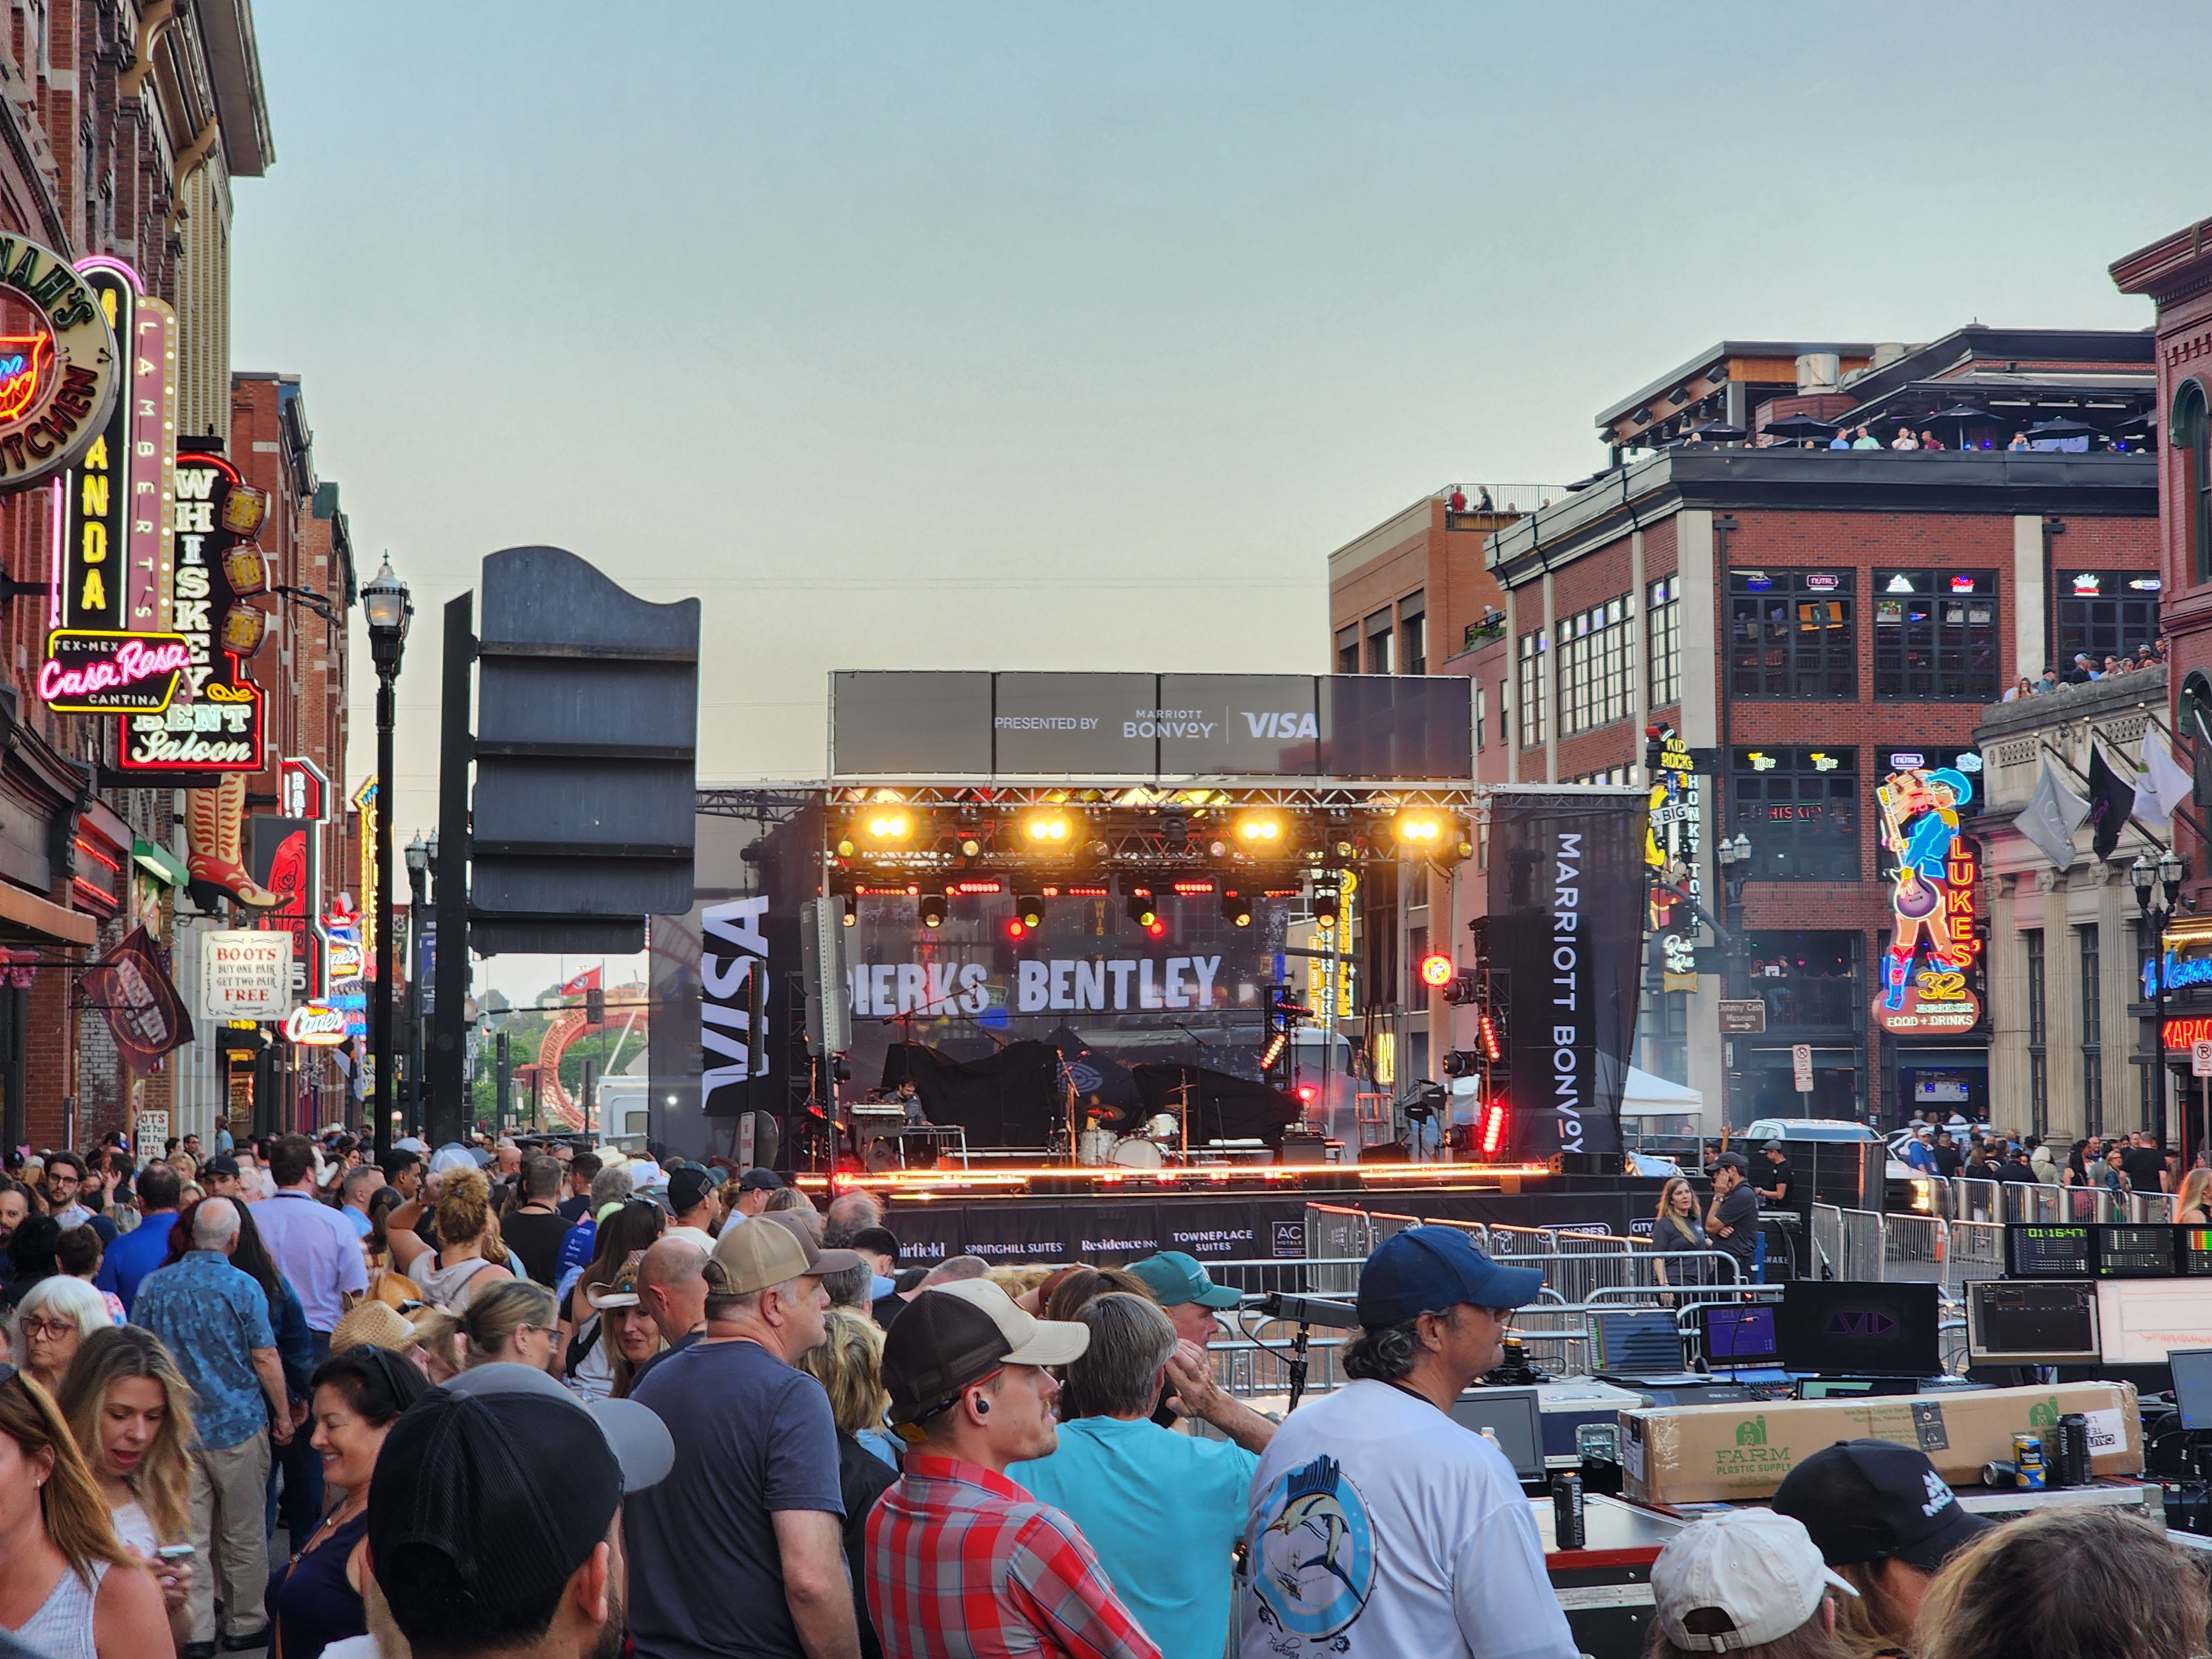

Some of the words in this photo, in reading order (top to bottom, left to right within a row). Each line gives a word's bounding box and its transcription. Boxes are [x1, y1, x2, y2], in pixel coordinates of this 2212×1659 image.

[173, 468, 220, 697] WHISKEY
[54, 640, 118, 652] TEX-MEX
[38, 659, 121, 701] Casa
[115, 639, 191, 686] Rosa
[88, 694, 159, 706] CANTINA
[1136, 709, 1203, 719] MARRIOTT
[994, 717, 1077, 730] PRESENTED
[1080, 718, 1099, 730] BY
[1123, 722, 1214, 739] BONVOY
[1239, 712, 1319, 739] VISA
[132, 731, 252, 763] Saloon
[1666, 738, 1687, 754] KID
[1662, 806, 1686, 822] BIG
[1687, 774, 1700, 853] HONKY
[1553, 833, 1582, 1011] MARRIOTT
[217, 947, 277, 961] BOOTS
[218, 964, 235, 974] BUY
[237, 964, 252, 973] ONE
[216, 977, 233, 986] GET
[235, 977, 254, 986] TWO
[848, 963, 990, 1016] IERKS
[1019, 955, 1223, 1011] BENTLEY
[1917, 971, 1966, 1000] 32
[225, 988, 270, 1001] FREE
[701, 895, 770, 1109] VISA
[1719, 1004, 1744, 1013] Johnny
[1747, 1003, 1763, 1011] Cash
[1914, 1003, 1974, 1014] BRIDGE
[286, 1006, 345, 1042] Cane's
[1886, 1016, 1918, 1027] FOOD
[1929, 1015, 1974, 1026] DRINKS
[1553, 1025, 1584, 1153] BONVOY
[1277, 1225, 1302, 1240] AC
[1632, 1223, 1653, 1233] CITY
[2028, 1228, 2085, 1238] 01:16:47
[1172, 1229, 1254, 1243] TOWNEPLACE
[1027, 1242, 1063, 1254] SUITES
[1081, 1239, 1142, 1252] Residence
[1142, 1239, 1158, 1248] INN
[1196, 1241, 1232, 1253] SUITES
[1715, 1446, 1792, 1464] FARM
[1717, 1465, 1755, 1476] PLASTIC
[1758, 1462, 1792, 1472] SUPPLY
